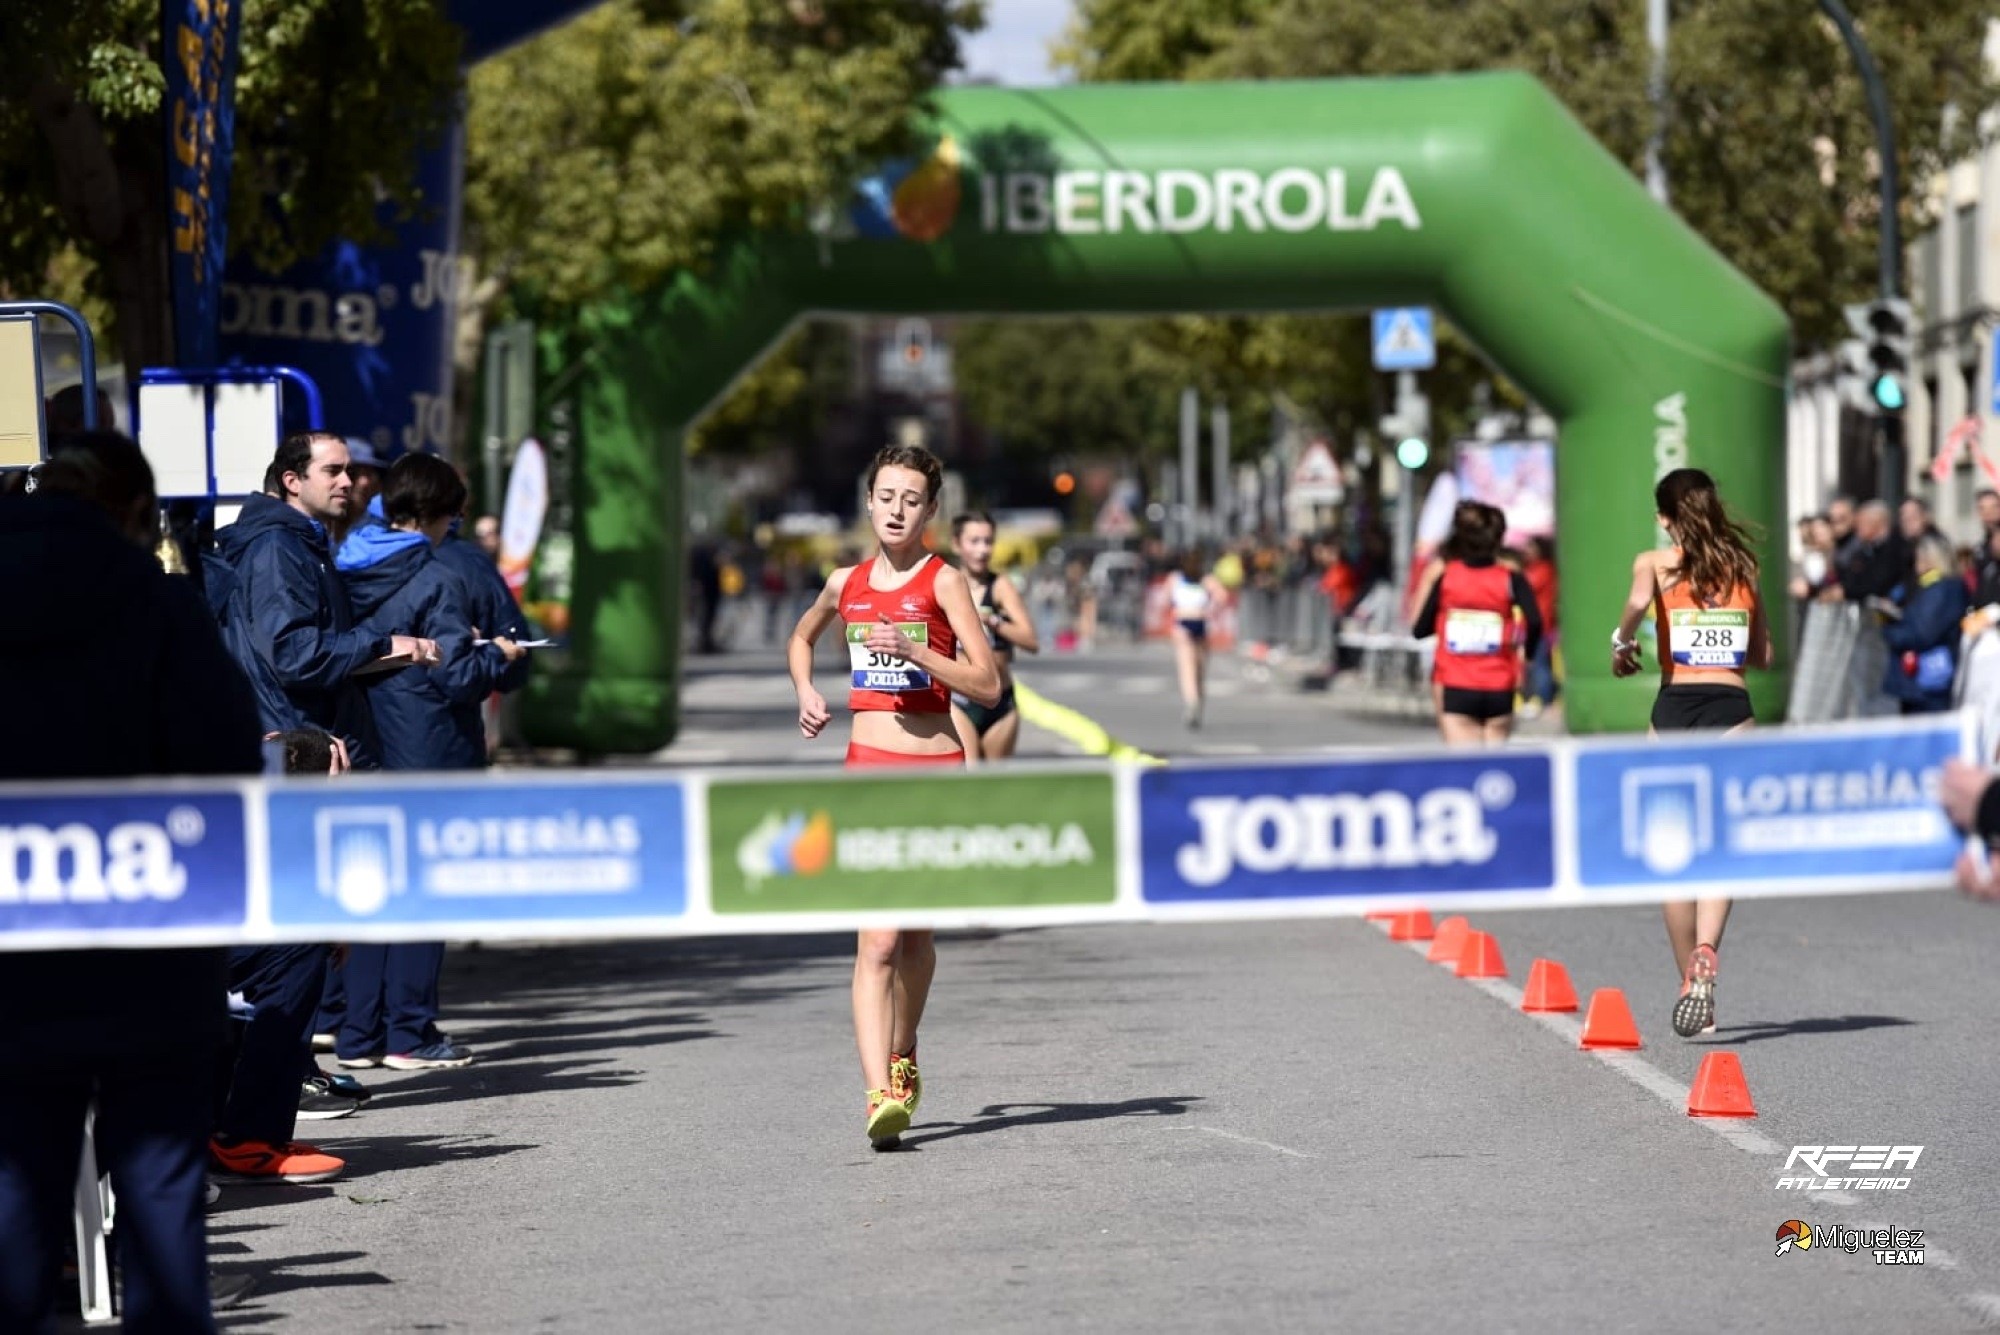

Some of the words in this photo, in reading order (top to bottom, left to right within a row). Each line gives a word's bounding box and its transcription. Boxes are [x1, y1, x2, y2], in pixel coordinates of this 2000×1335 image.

[978, 166, 1421, 234] IBERDROLA
[1691, 630, 1733, 647] 288
[416, 809, 642, 857] LOTERÍAS
[837, 823, 1094, 872] IBERDROLA
